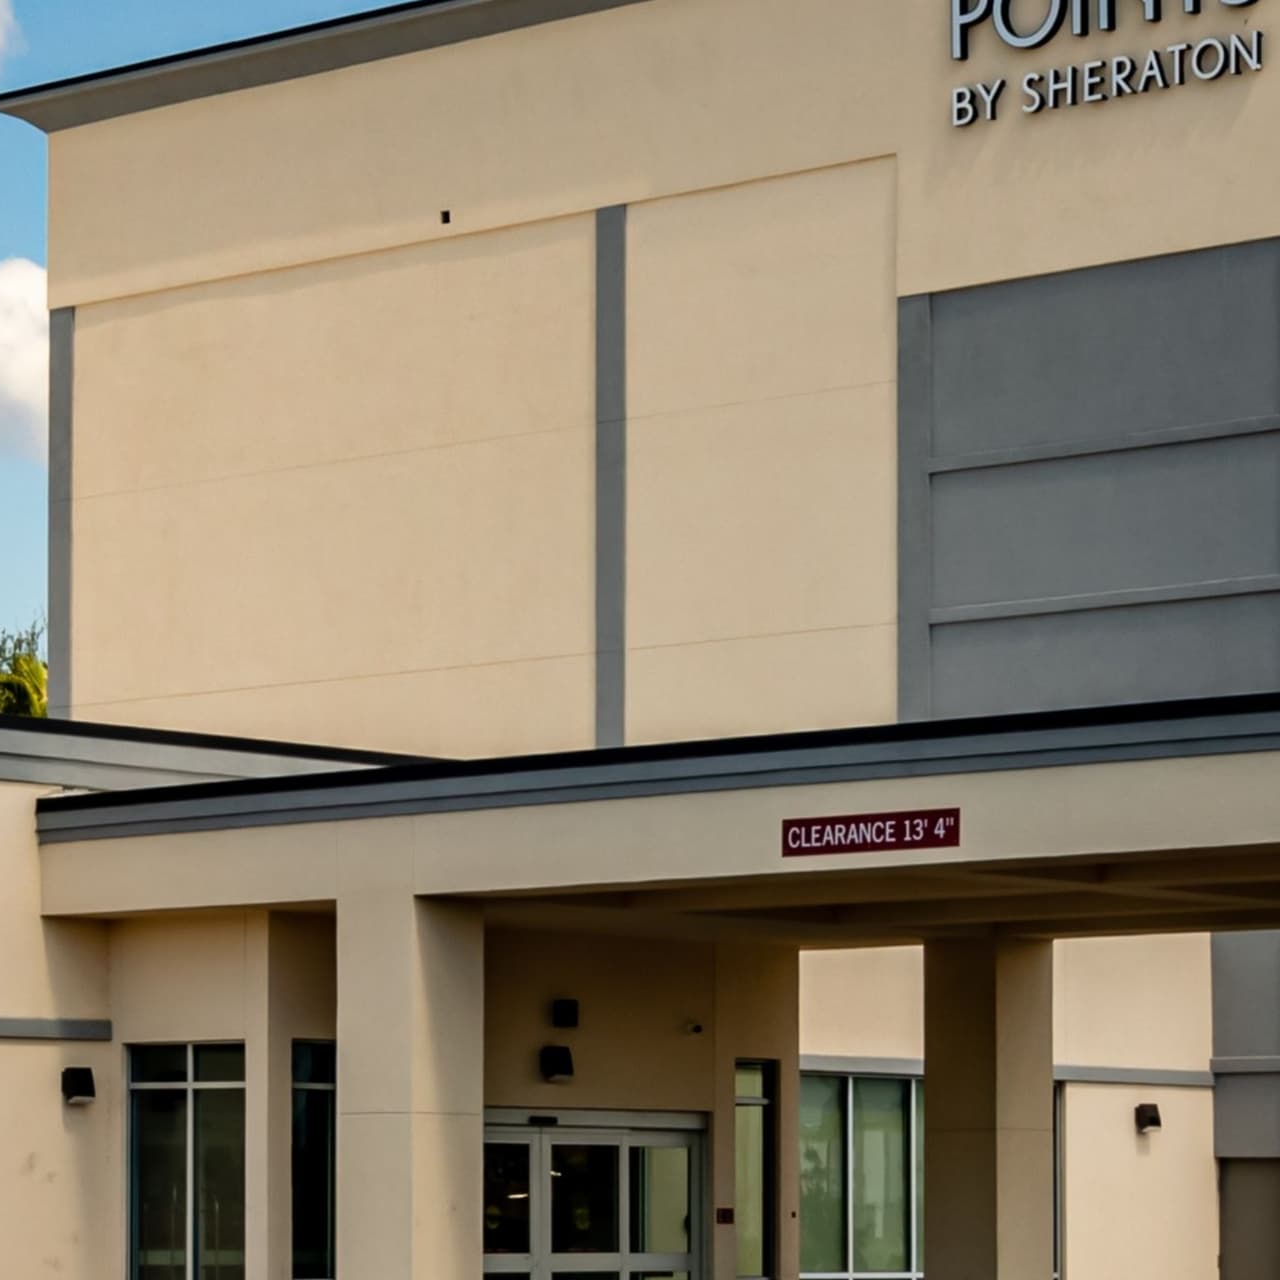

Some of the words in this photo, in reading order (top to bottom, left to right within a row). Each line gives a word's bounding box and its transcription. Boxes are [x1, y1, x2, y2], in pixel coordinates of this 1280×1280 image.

[951, 79, 1005, 126] BY
[1022, 30, 1263, 114] SHERATON
[788, 821, 896, 849] CLEARANCE
